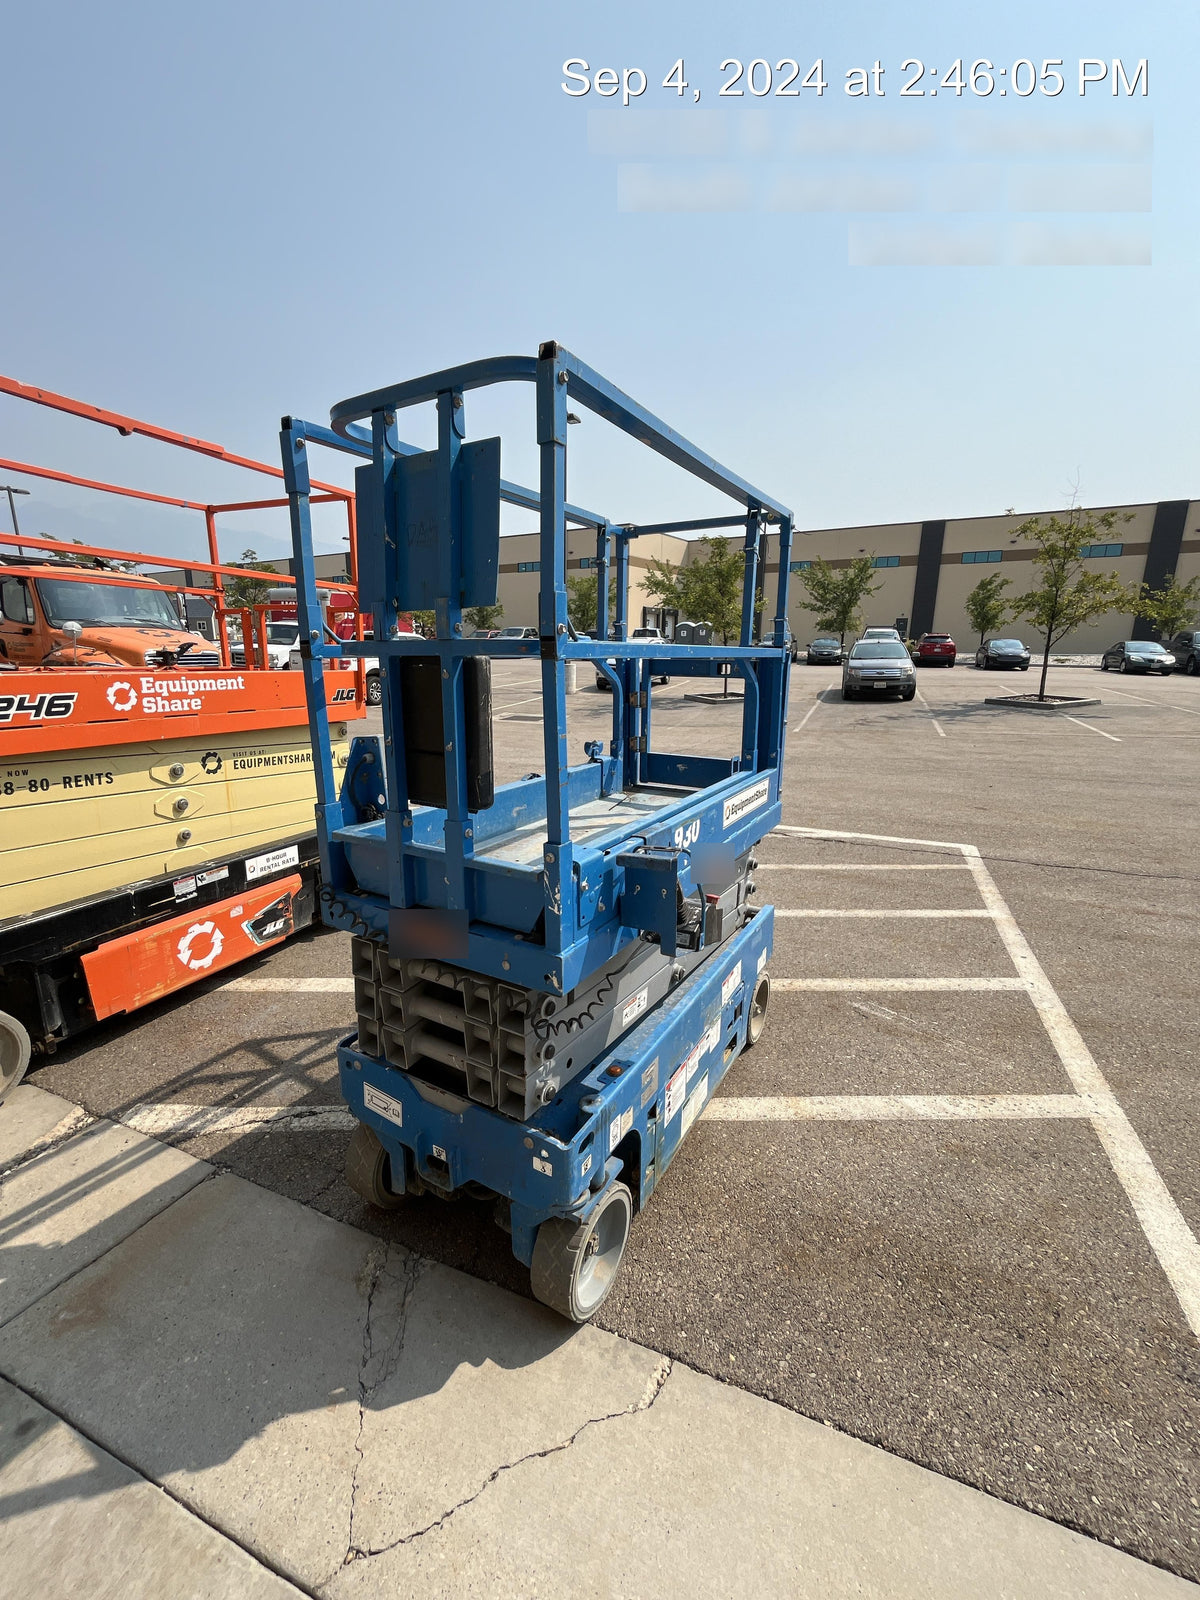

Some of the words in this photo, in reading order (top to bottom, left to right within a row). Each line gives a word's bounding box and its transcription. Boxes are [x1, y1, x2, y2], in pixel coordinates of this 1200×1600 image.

[139, 675, 245, 696] Equipment
[331, 688, 356, 702] JLG
[141, 697, 202, 714] Share
[7, 769, 29, 777] NOW
[0, 772, 114, 796] 8-80-RENTS
[259, 862, 281, 872] RENTAL
[281, 856, 296, 866] RATE
